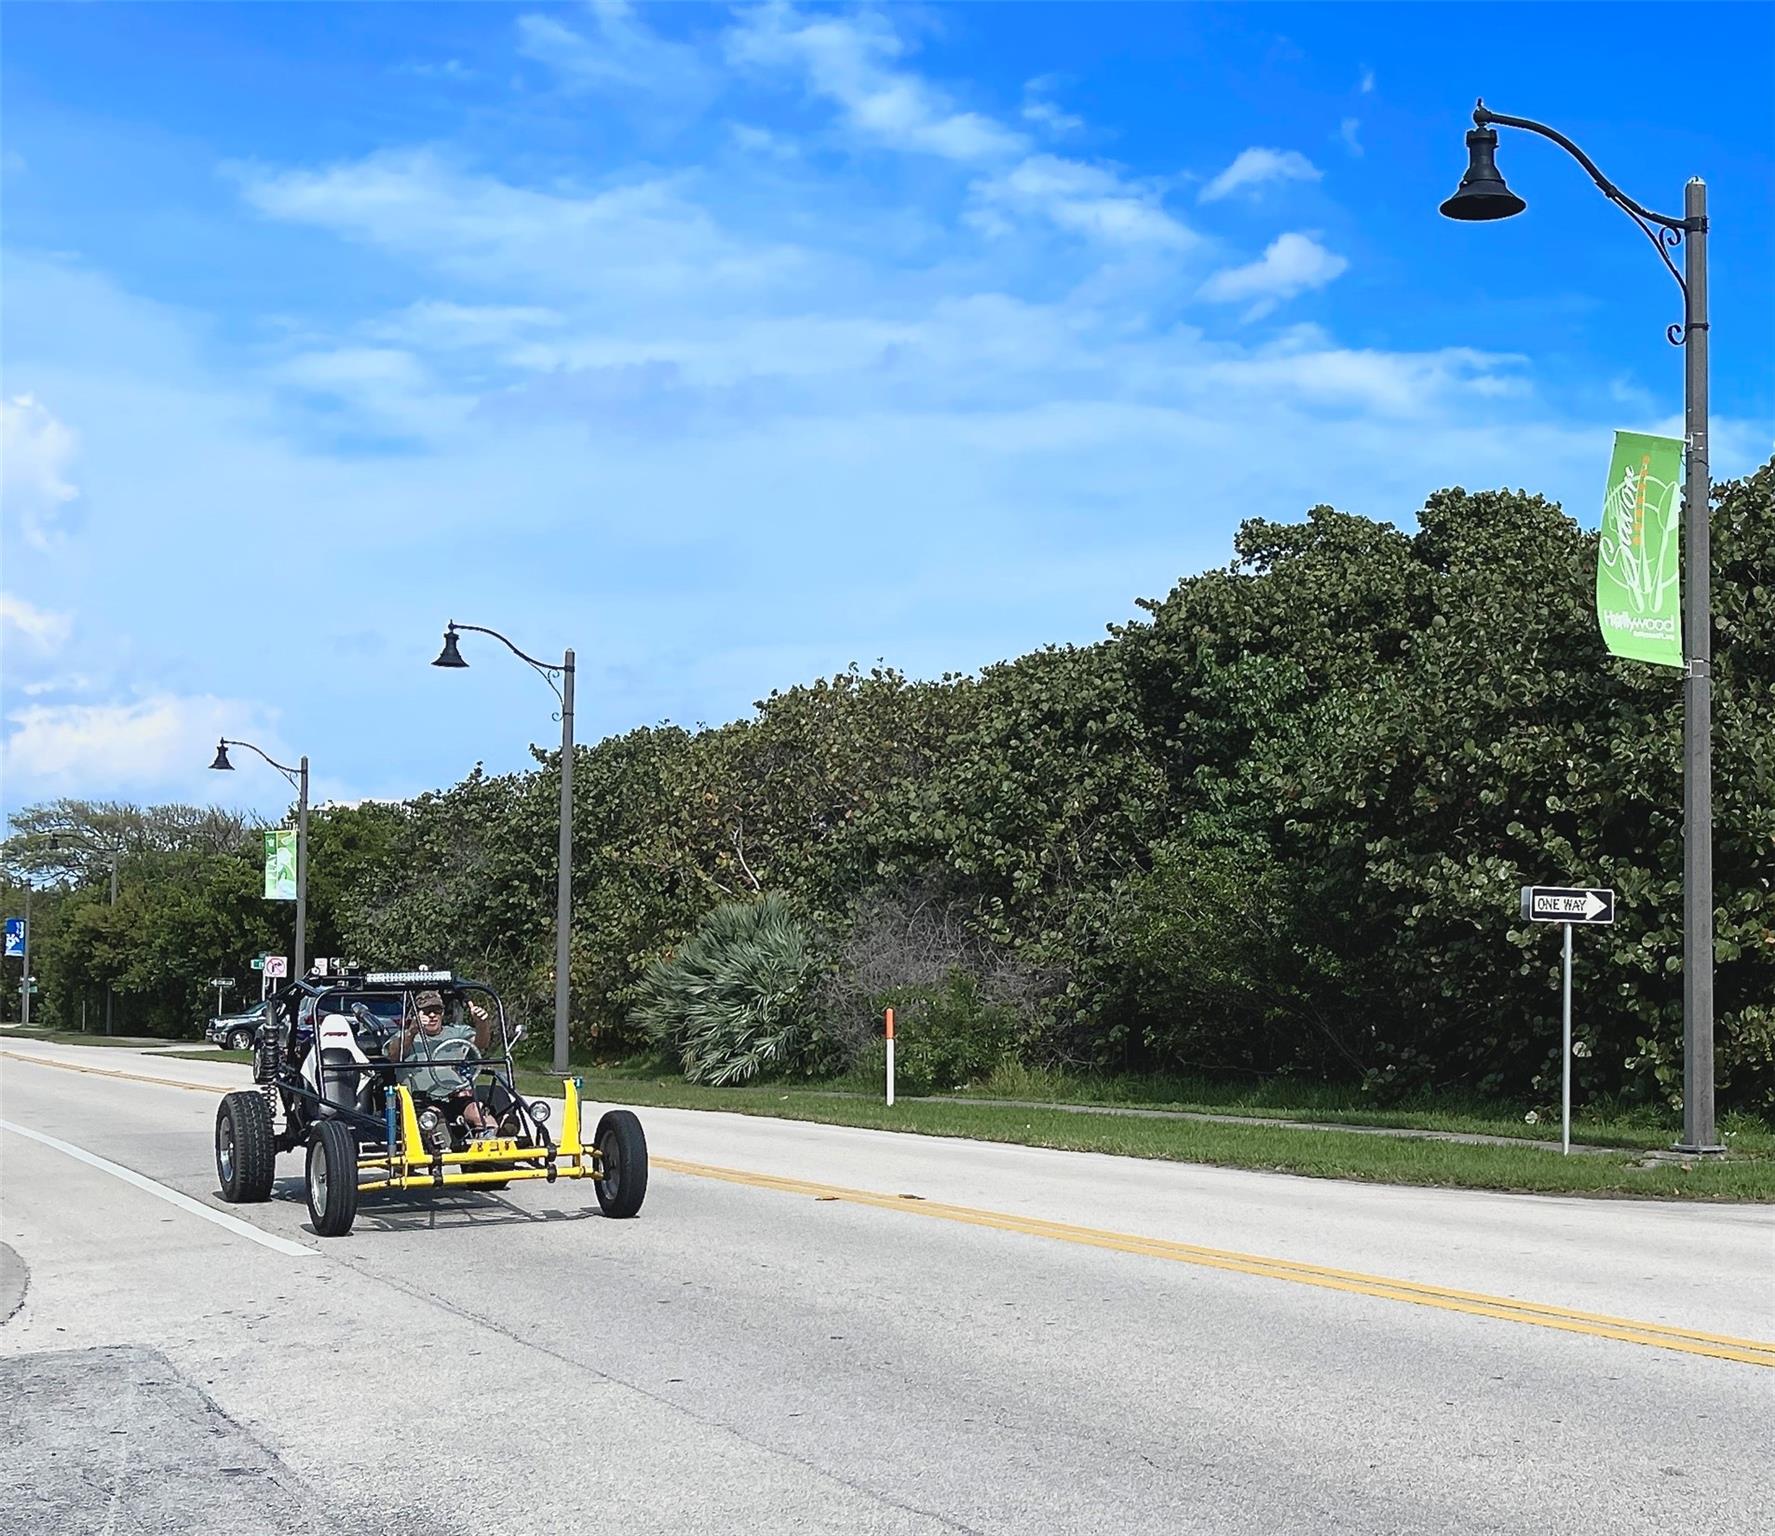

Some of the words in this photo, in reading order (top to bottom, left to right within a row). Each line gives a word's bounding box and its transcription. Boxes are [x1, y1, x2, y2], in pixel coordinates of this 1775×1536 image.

[1603, 609, 1675, 633] Hollywood
[1537, 897, 1560, 911] ONE
[1563, 898, 1587, 912] WAY
